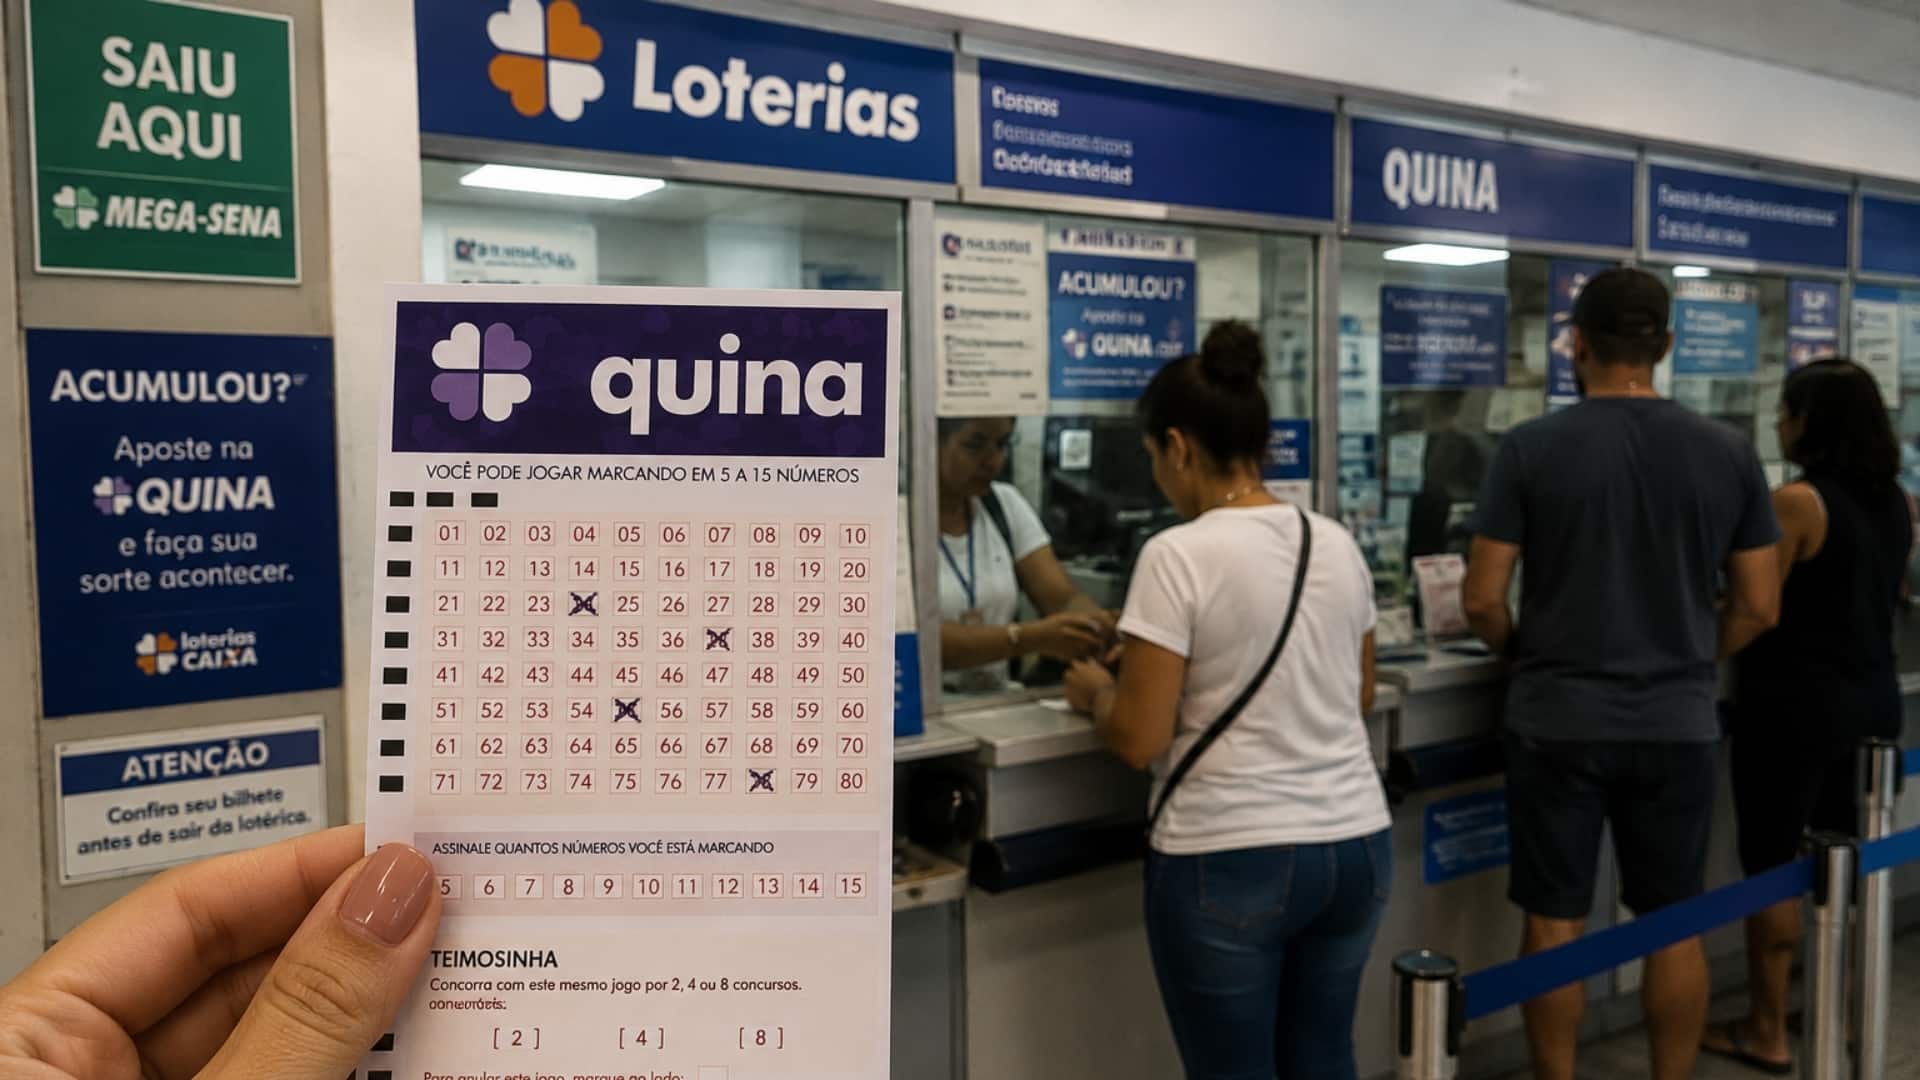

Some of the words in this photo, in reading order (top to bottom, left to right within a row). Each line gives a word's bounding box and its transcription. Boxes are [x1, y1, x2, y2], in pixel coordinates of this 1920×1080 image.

[102, 36, 237, 99] SAIU
[633, 39, 921, 142] Loterias
[97, 102, 243, 162] AQUI
[1384, 149, 1498, 212] QUINA
[105, 196, 281, 238] MEGA-SENA
[1058, 270, 1185, 300] ACUMULOU?
[51, 370, 290, 402] ACUMULOU?
[591, 333, 862, 435] quina
[114, 435, 212, 467] Aposte
[221, 441, 253, 459] na
[426, 460, 472, 480] VOCÊ
[477, 464, 521, 480] PODE
[526, 464, 583, 481] JOGAR
[587, 466, 687, 482] MARCANDO
[691, 466, 716, 482] EM
[720, 466, 730, 483] 5
[735, 467, 748, 482] A
[753, 467, 772, 483] 15
[776, 463, 860, 484] NÚMEROS
[137, 477, 274, 515] QUINA
[118, 538, 137, 557] e
[145, 529, 204, 561] faça
[212, 533, 257, 552] sua
[439, 524, 459, 542] 01
[483, 524, 506, 542] 02
[528, 525, 552, 543] 03
[573, 525, 596, 543] 04
[617, 525, 641, 543] 05
[662, 526, 686, 543] 06
[708, 526, 732, 544] 07
[753, 526, 776, 544] 08
[799, 526, 822, 544] 09
[845, 527, 867, 545] 10
[81, 569, 150, 593] sorte
[160, 564, 293, 588] acontecer.
[441, 559, 459, 576] 11
[485, 559, 506, 577] 12
[530, 560, 551, 577] 13
[574, 560, 595, 577] 14
[619, 560, 640, 577] 15
[664, 561, 685, 578] 16
[709, 560, 731, 577] 17
[754, 561, 776, 578] 18
[800, 561, 821, 578] 19
[843, 561, 866, 579] 20
[438, 594, 458, 612] 21
[482, 595, 505, 612] 22
[527, 595, 550, 613] 23
[617, 595, 640, 613] 25
[662, 595, 685, 613] 26
[707, 595, 730, 613] 27
[752, 596, 775, 613] 28
[798, 596, 821, 613] 29
[842, 596, 866, 613] 30
[180, 628, 257, 649] loterias
[437, 630, 457, 648] 31
[482, 630, 505, 648] 32
[527, 630, 550, 648] 33
[571, 630, 595, 648] 34
[616, 631, 639, 648] 35
[661, 631, 685, 648] 36
[751, 631, 775, 649] 38
[797, 631, 820, 649] 39
[841, 631, 865, 649] 40
[181, 649, 258, 671] CAIXA
[436, 666, 457, 683] 41
[481, 666, 505, 684] 42
[526, 666, 550, 683] 43
[570, 666, 594, 683] 44
[615, 666, 639, 684] 45
[660, 666, 684, 684] 46
[705, 666, 729, 683] 47
[750, 666, 774, 684] 48
[796, 666, 820, 683] 49
[842, 666, 865, 684] 50
[435, 702, 456, 719] 51
[480, 701, 504, 719] 52
[525, 701, 549, 719] 53
[570, 702, 593, 719] 54
[660, 702, 684, 719] 56
[705, 701, 729, 719] 57
[751, 702, 774, 719] 58
[796, 702, 820, 719] 59
[841, 702, 865, 719] 60
[435, 737, 455, 755] 61
[480, 737, 503, 755] 62
[525, 737, 548, 755] 63
[569, 737, 593, 754] 64
[614, 737, 638, 754] 65
[660, 737, 683, 754] 66
[705, 737, 728, 754] 67
[750, 737, 774, 754] 68
[796, 737, 819, 754] 69
[841, 737, 864, 754] 70
[122, 741, 269, 782] ATENÇÃO
[435, 773, 455, 791] 71
[479, 773, 503, 791] 72
[524, 773, 548, 791] 73
[569, 773, 593, 790] 74
[614, 772, 637, 790] 75
[659, 772, 682, 790] 76
[704, 772, 728, 790] 77
[795, 772, 818, 790] 79
[840, 772, 864, 790] 80
[108, 802, 179, 824] Confira
[186, 799, 217, 813] seu
[222, 789, 283, 808] bilhete
[78, 837, 132, 854] antes
[138, 829, 162, 845] de
[169, 823, 203, 842] sair
[209, 820, 233, 836] da
[239, 812, 312, 831] lotérica.
[431, 842, 492, 855] ASSINALE
[494, 841, 559, 855] QUANTOS
[561, 839, 626, 855] NÚMEROS
[628, 839, 664, 855] VOCÊ
[666, 839, 696, 854] ESTÁ
[697, 841, 775, 854] MARCANDO
[440, 878, 451, 896] 5
[483, 879, 495, 896] 6
[525, 878, 536, 896] 7
[563, 878, 574, 896] 8
[603, 878, 614, 895] 9
[639, 878, 660, 895] 10
[678, 878, 696, 895] 11
[718, 878, 739, 895] 12
[758, 877, 779, 895] 13
[799, 877, 820, 894] 14
[841, 877, 862, 894] 15
[430, 949, 560, 969] TEIMOSINHA
[429, 977, 493, 992] Concorra
[496, 981, 525, 992] com
[528, 978, 556, 991] este
[559, 981, 608, 991] mesmo
[610, 977, 641, 995] jogo
[645, 981, 669, 994] por
[671, 977, 684, 993] 2,
[687, 977, 696, 991] 4
[699, 981, 717, 991] ou
[719, 977, 729, 991] 8
[732, 980, 802, 991] concursos.
